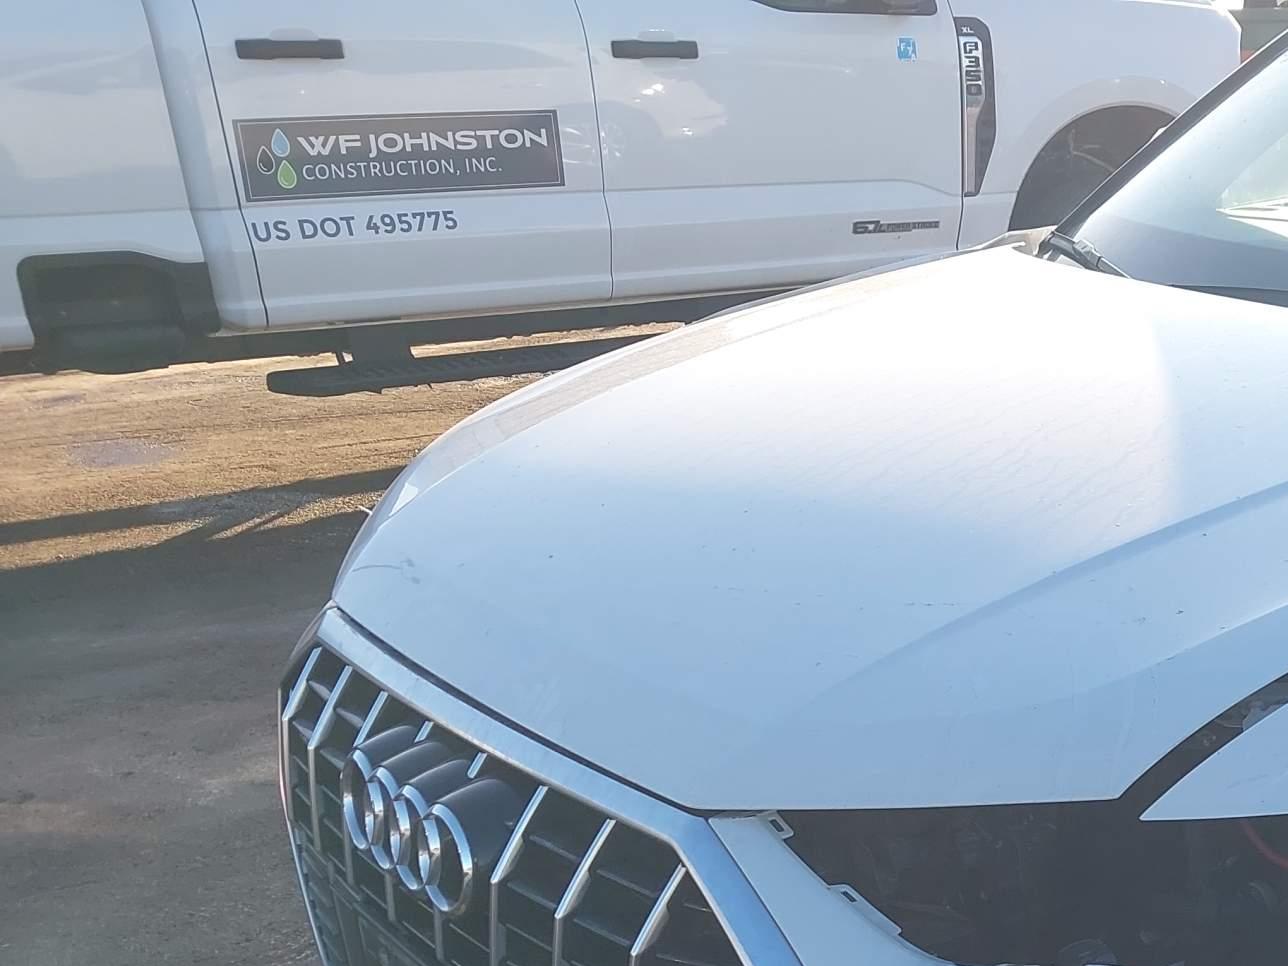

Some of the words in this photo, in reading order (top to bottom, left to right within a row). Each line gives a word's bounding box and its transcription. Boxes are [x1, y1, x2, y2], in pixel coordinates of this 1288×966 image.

[963, 41, 982, 96] F350
[296, 133, 361, 156] WF
[368, 127, 548, 158] JOHNSTON
[302, 158, 461, 181] CONSTRUCTION,
[464, 157, 503, 173] INC.
[251, 220, 291, 243] US
[297, 215, 356, 240] DOT
[365, 210, 458, 236] 495775
